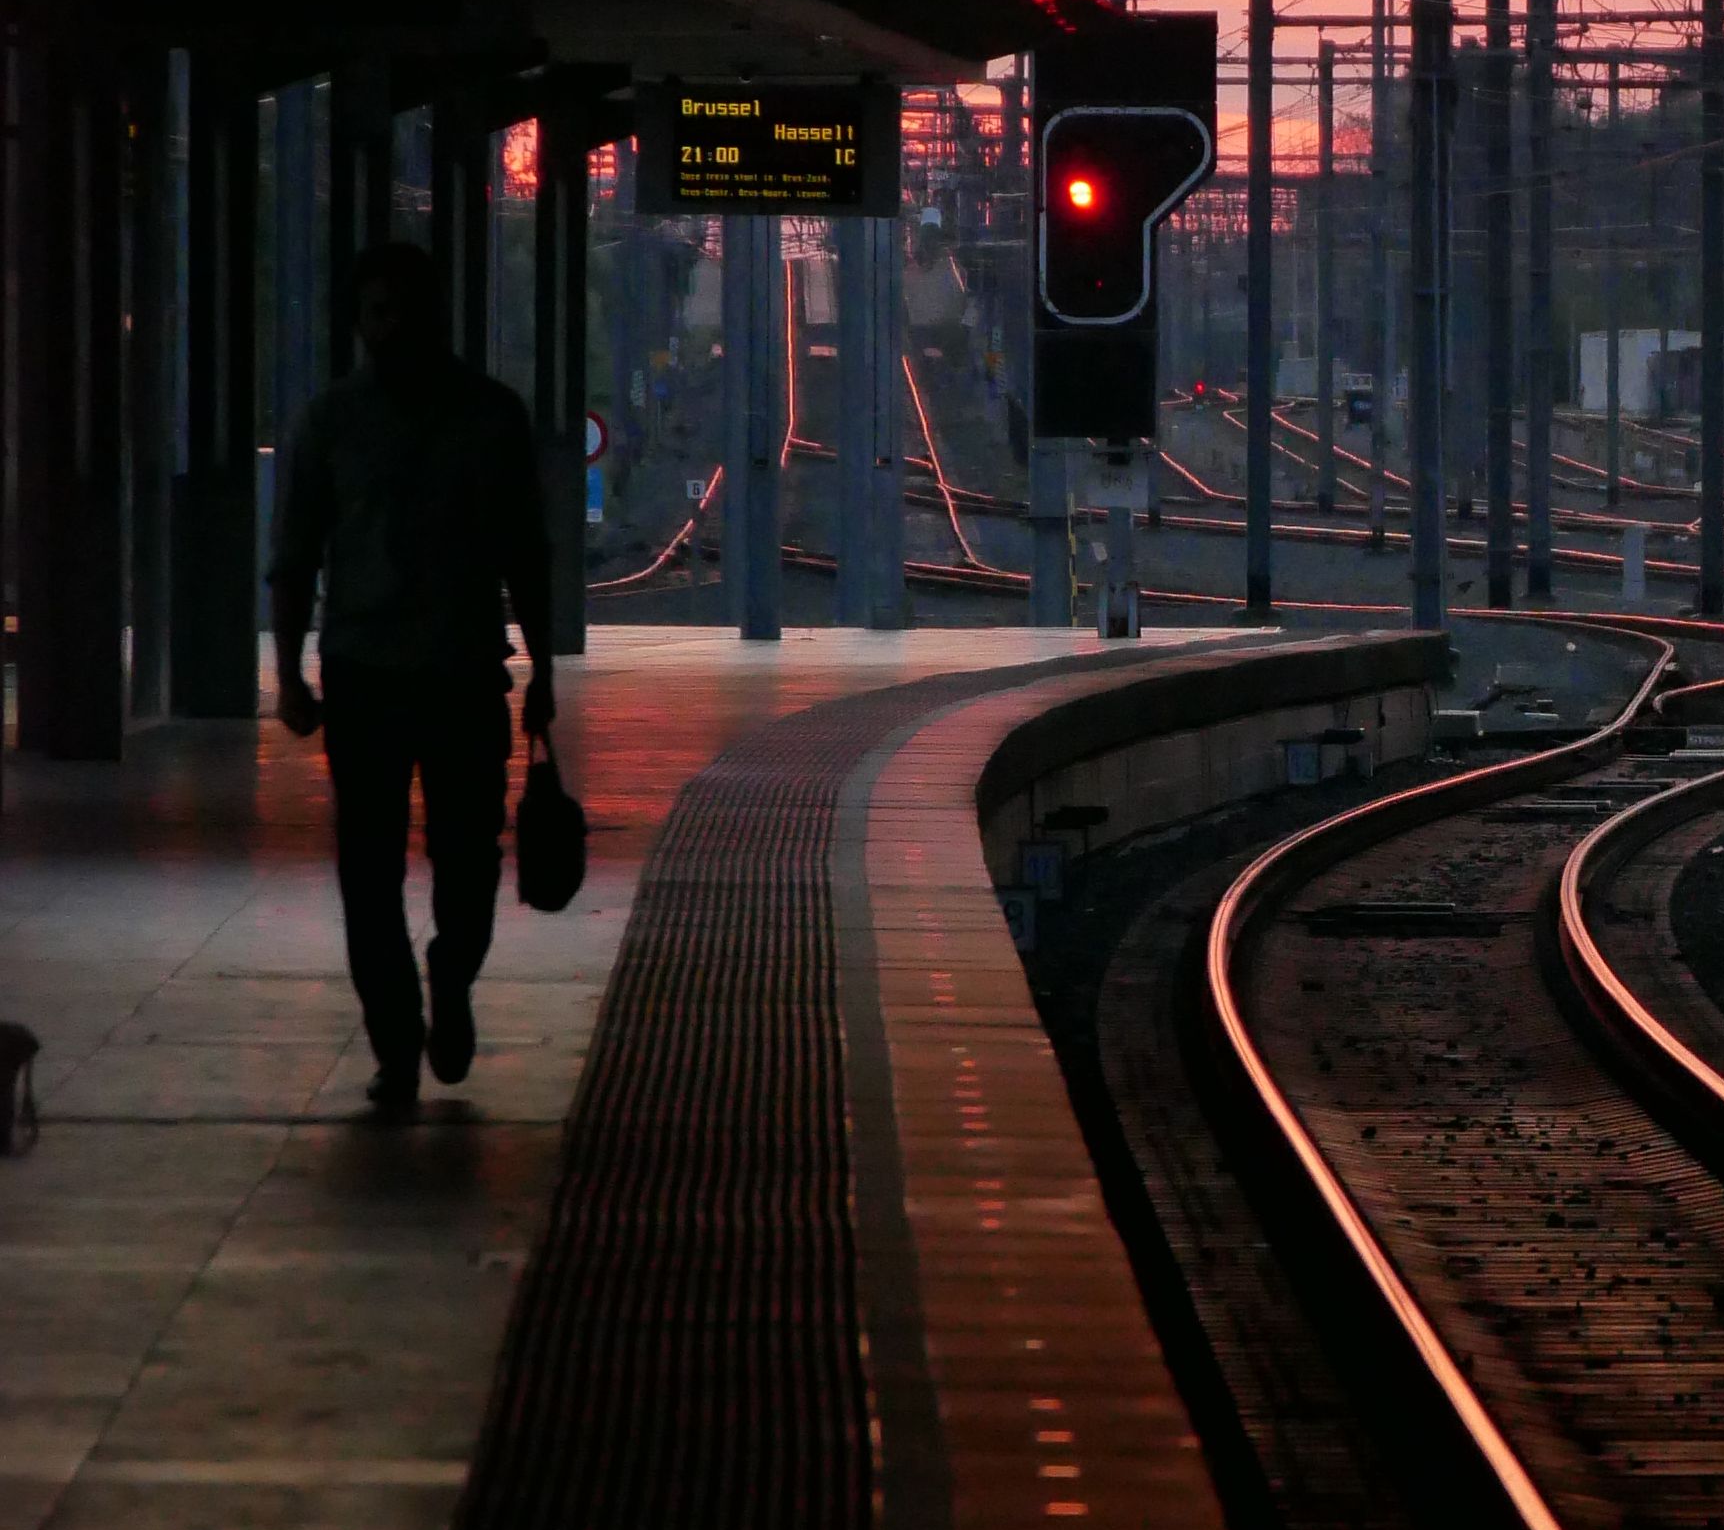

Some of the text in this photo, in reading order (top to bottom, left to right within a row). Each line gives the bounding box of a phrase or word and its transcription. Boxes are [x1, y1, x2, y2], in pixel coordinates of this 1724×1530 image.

[681, 99, 761, 117] Brussel
[774, 124, 854, 141] Hasselt
[681, 146, 856, 165] 21:00 IC
